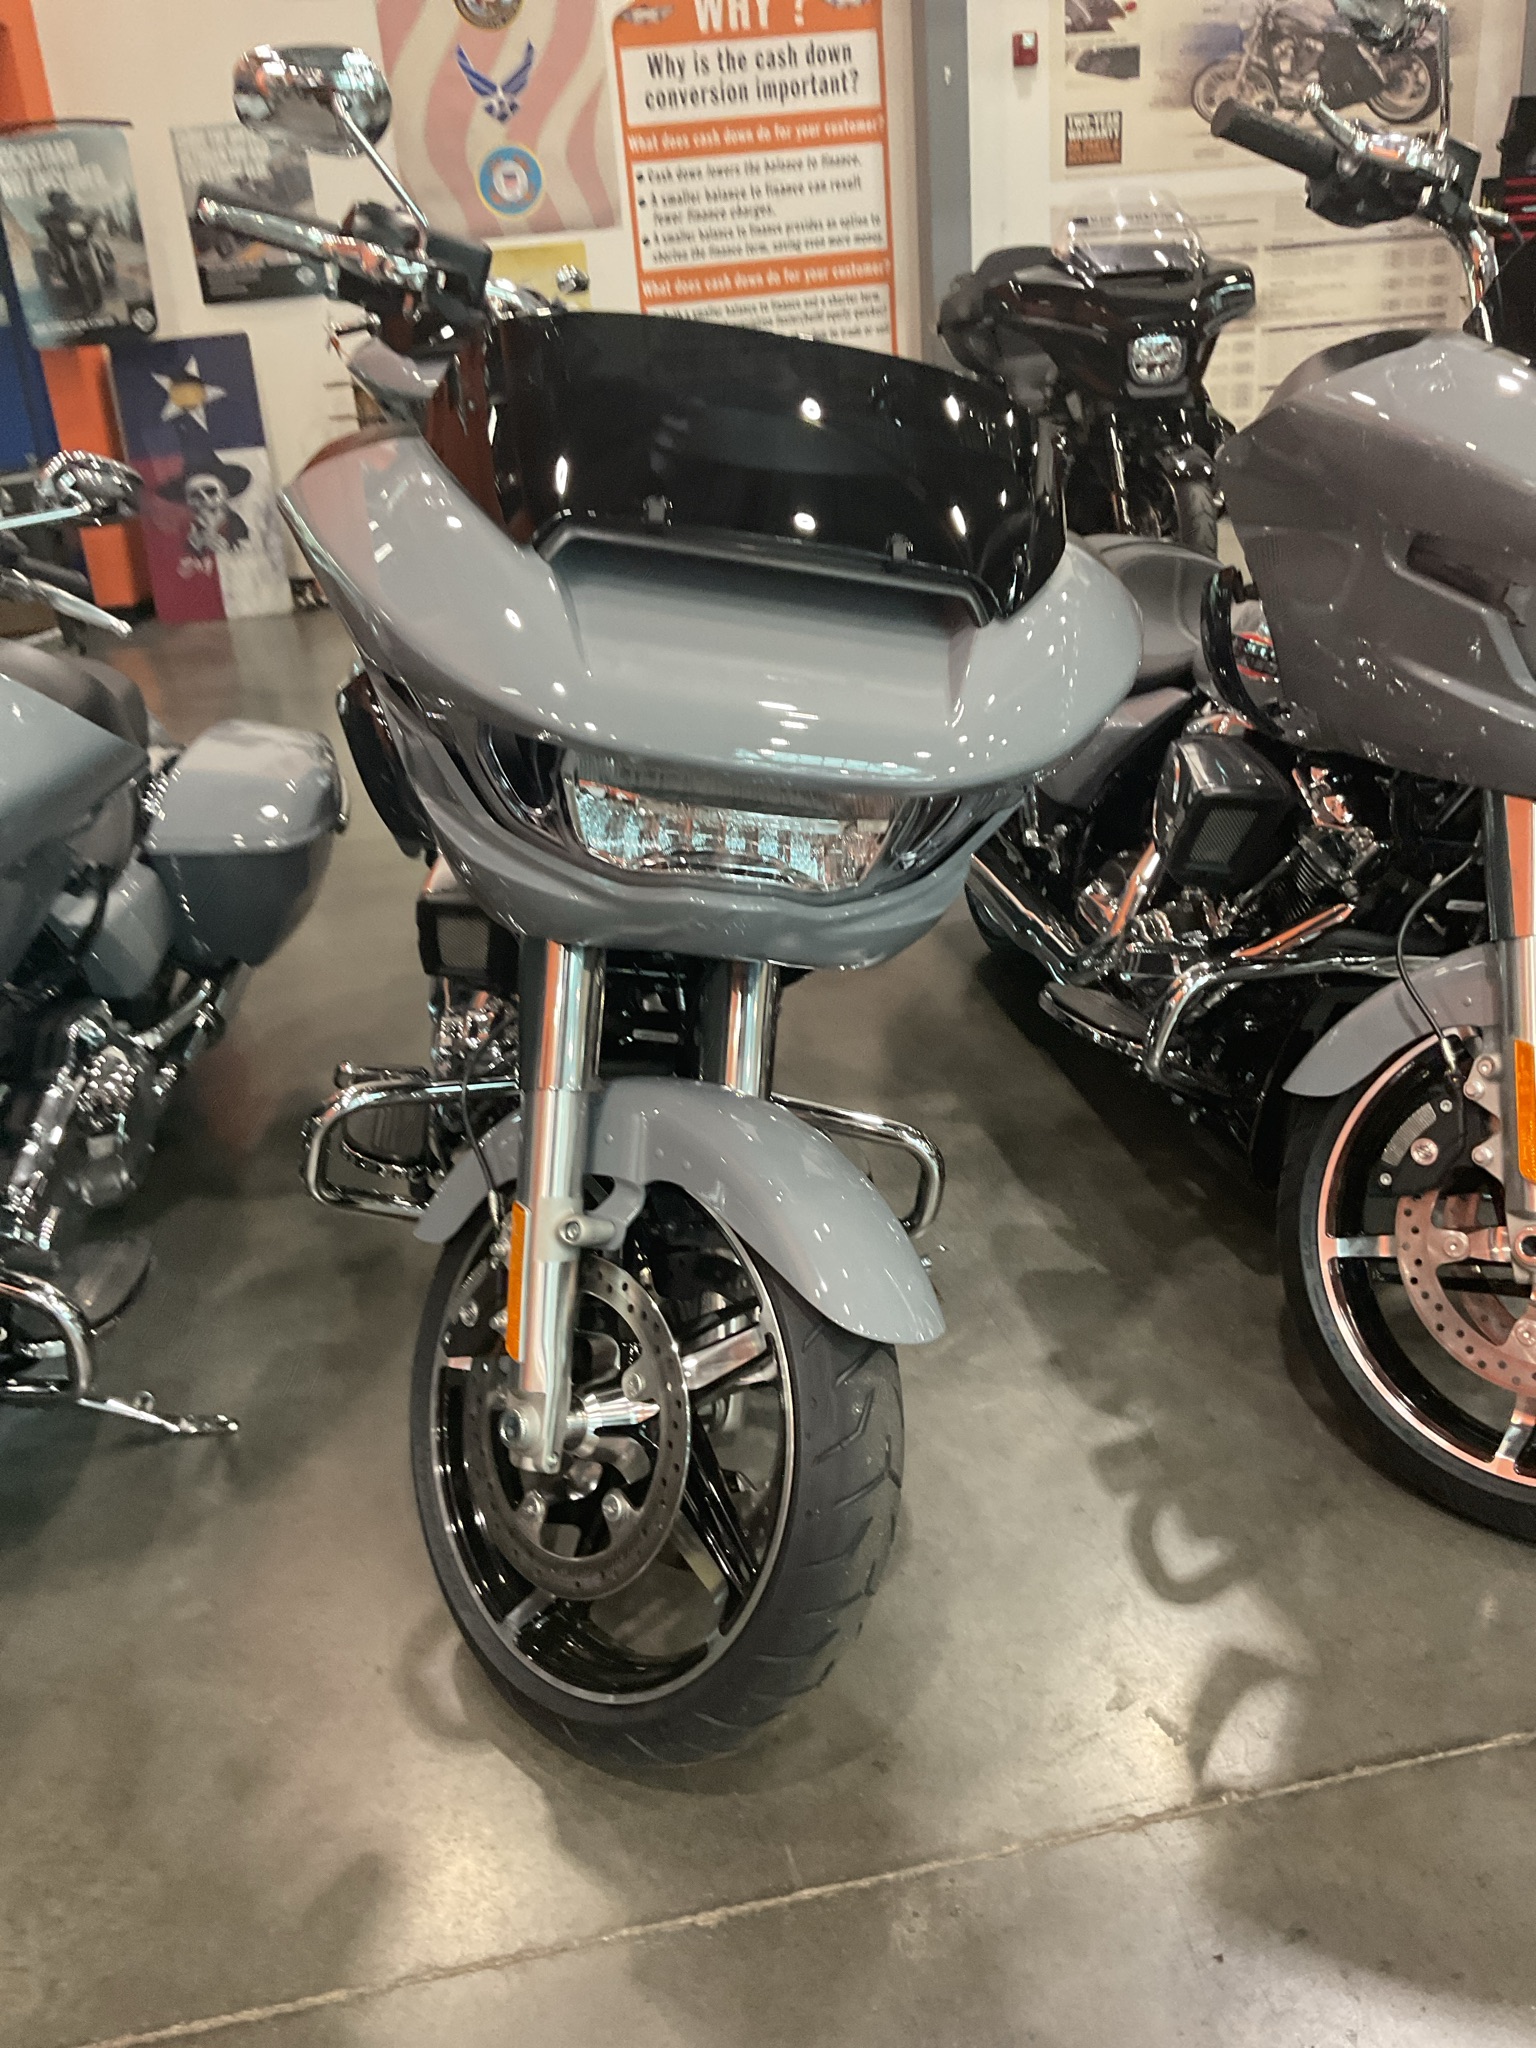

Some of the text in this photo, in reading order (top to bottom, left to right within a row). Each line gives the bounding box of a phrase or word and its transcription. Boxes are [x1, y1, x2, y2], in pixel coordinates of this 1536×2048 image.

[694, 0, 768, 34] WHY
[647, 39, 852, 82] Why is the cash down
[645, 68, 859, 112] conversion important?
[627, 132, 659, 154] What
[662, 131, 691, 152] does
[693, 127, 721, 149] cash
[724, 126, 754, 146] down
[756, 124, 772, 142] do
[774, 122, 791, 141] for
[796, 123, 820, 143] your
[641, 278, 672, 299] What
